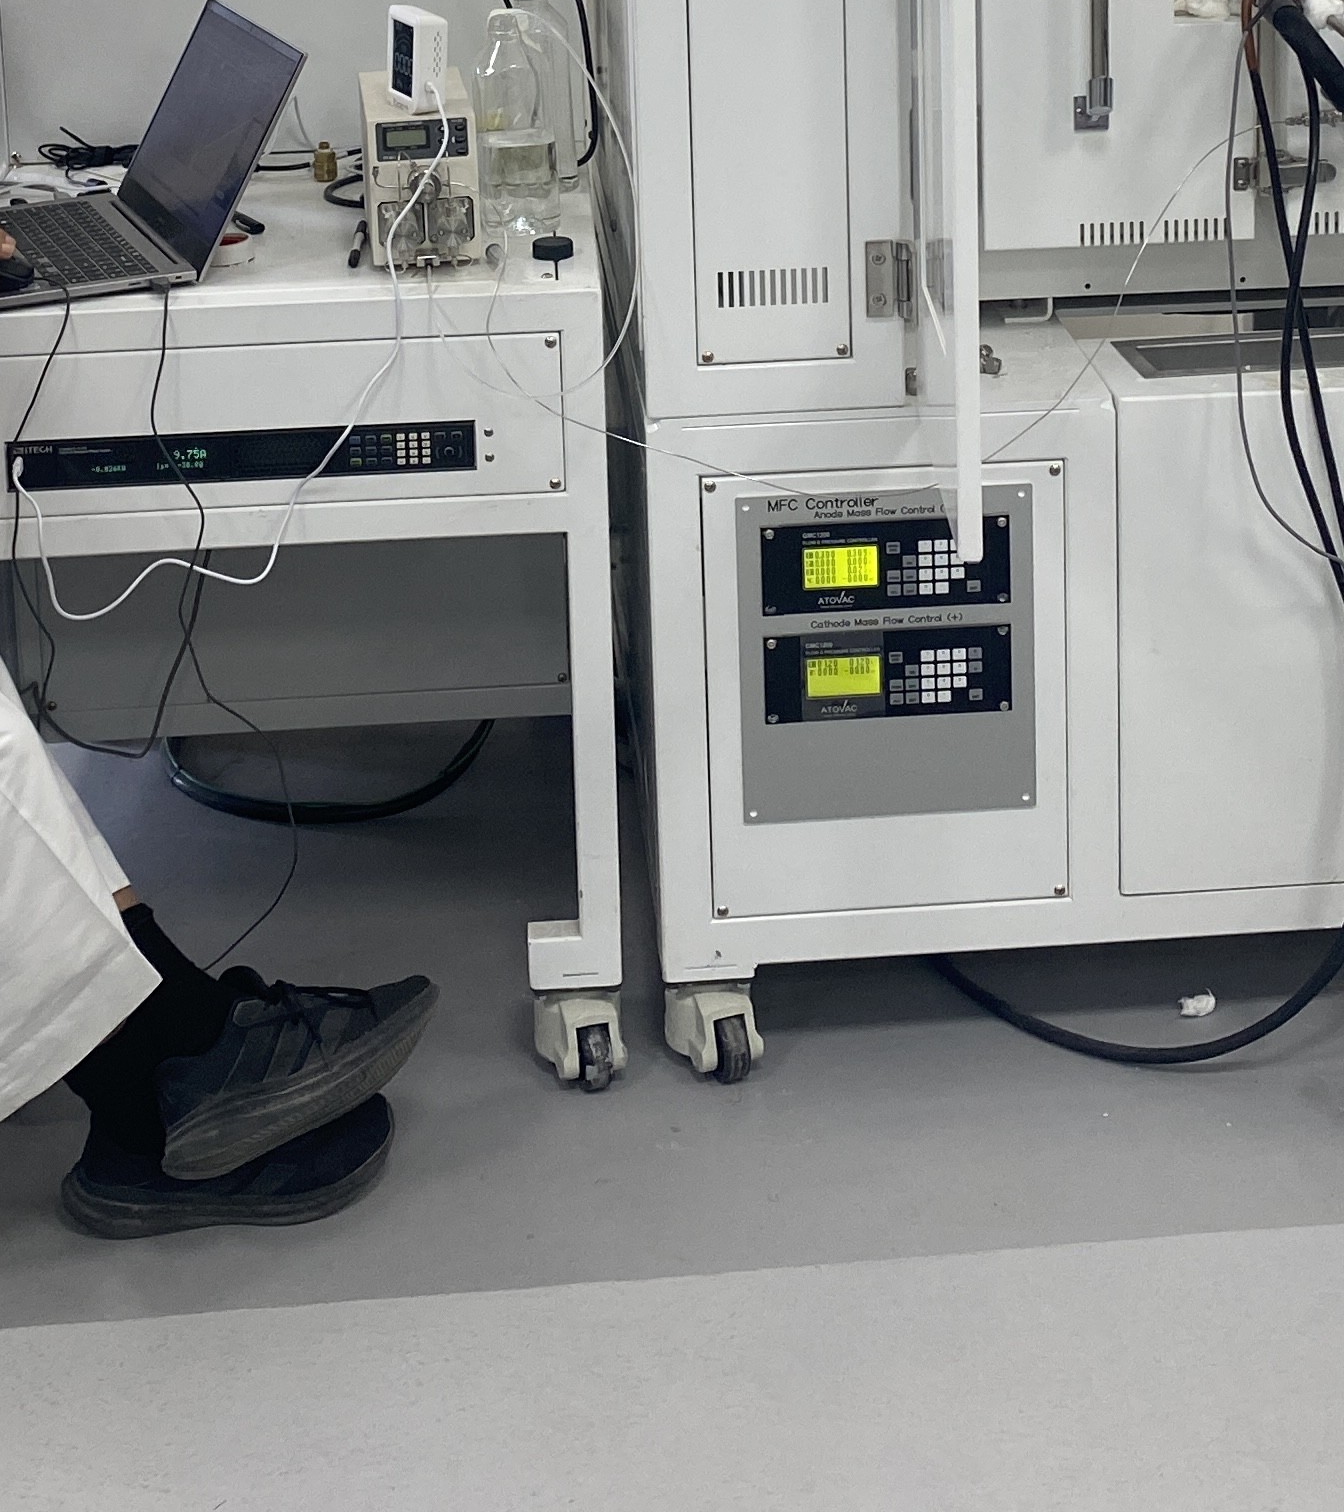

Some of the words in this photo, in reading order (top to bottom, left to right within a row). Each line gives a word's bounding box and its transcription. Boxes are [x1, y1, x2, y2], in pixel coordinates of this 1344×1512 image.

[767, 499, 798, 512] MFC
[805, 496, 879, 510] Controller
[814, 510, 843, 519] Anode
[847, 509, 871, 518] Mass
[875, 507, 897, 516] Flow
[900, 505, 935, 515] Control
[818, 591, 855, 604] ATOVAC
[811, 619, 851, 629] Cathode
[854, 618, 879, 627] Mass
[883, 616, 904, 625] Flow
[908, 614, 942, 624] Control
[947, 613, 963, 622] (+)
[821, 700, 857, 713] ATOVAC
